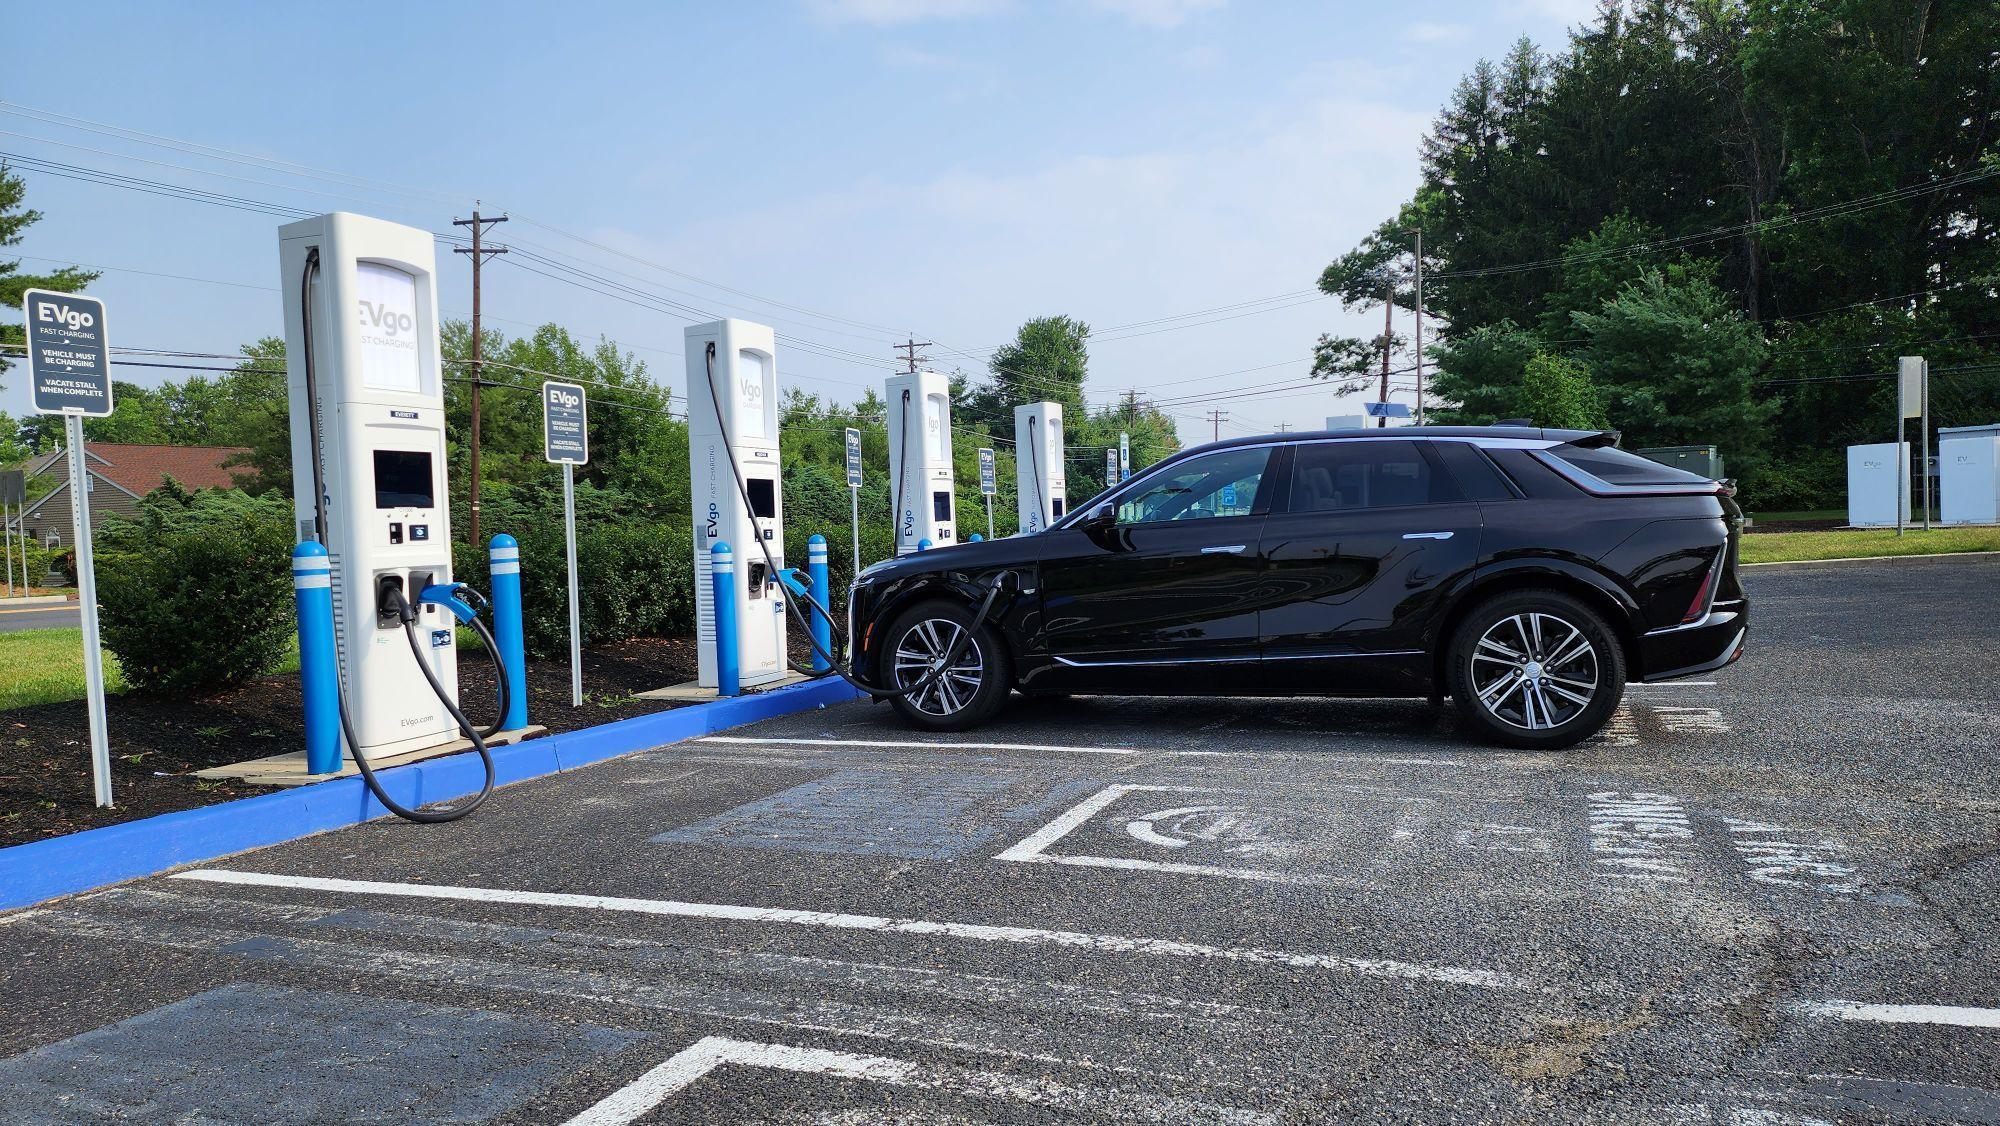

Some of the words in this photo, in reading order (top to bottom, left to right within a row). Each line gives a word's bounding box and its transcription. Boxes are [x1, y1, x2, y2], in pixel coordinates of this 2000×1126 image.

[38, 301, 94, 330] EVgo
[40, 327, 57, 336] FAST
[58, 329, 96, 340] CHARGING
[373, 337, 415, 350] CHARGING
[42, 348, 74, 359] VEHICLE
[75, 352, 97, 361] MUST
[45, 356, 55, 364] BE
[55, 358, 95, 368] CHARGING
[40, 385, 64, 394] WHEN
[64, 388, 104, 397] COMPLETE
[45, 379, 75, 388] VACATE
[75, 381, 98, 390] STALL
[550, 389, 579, 408] EVgo
[706, 502, 720, 538] EVgo
[904, 509, 914, 537] EVgo
[1029, 512, 1038, 533] EVgo
[401, 715, 434, 728] EVgo.com
